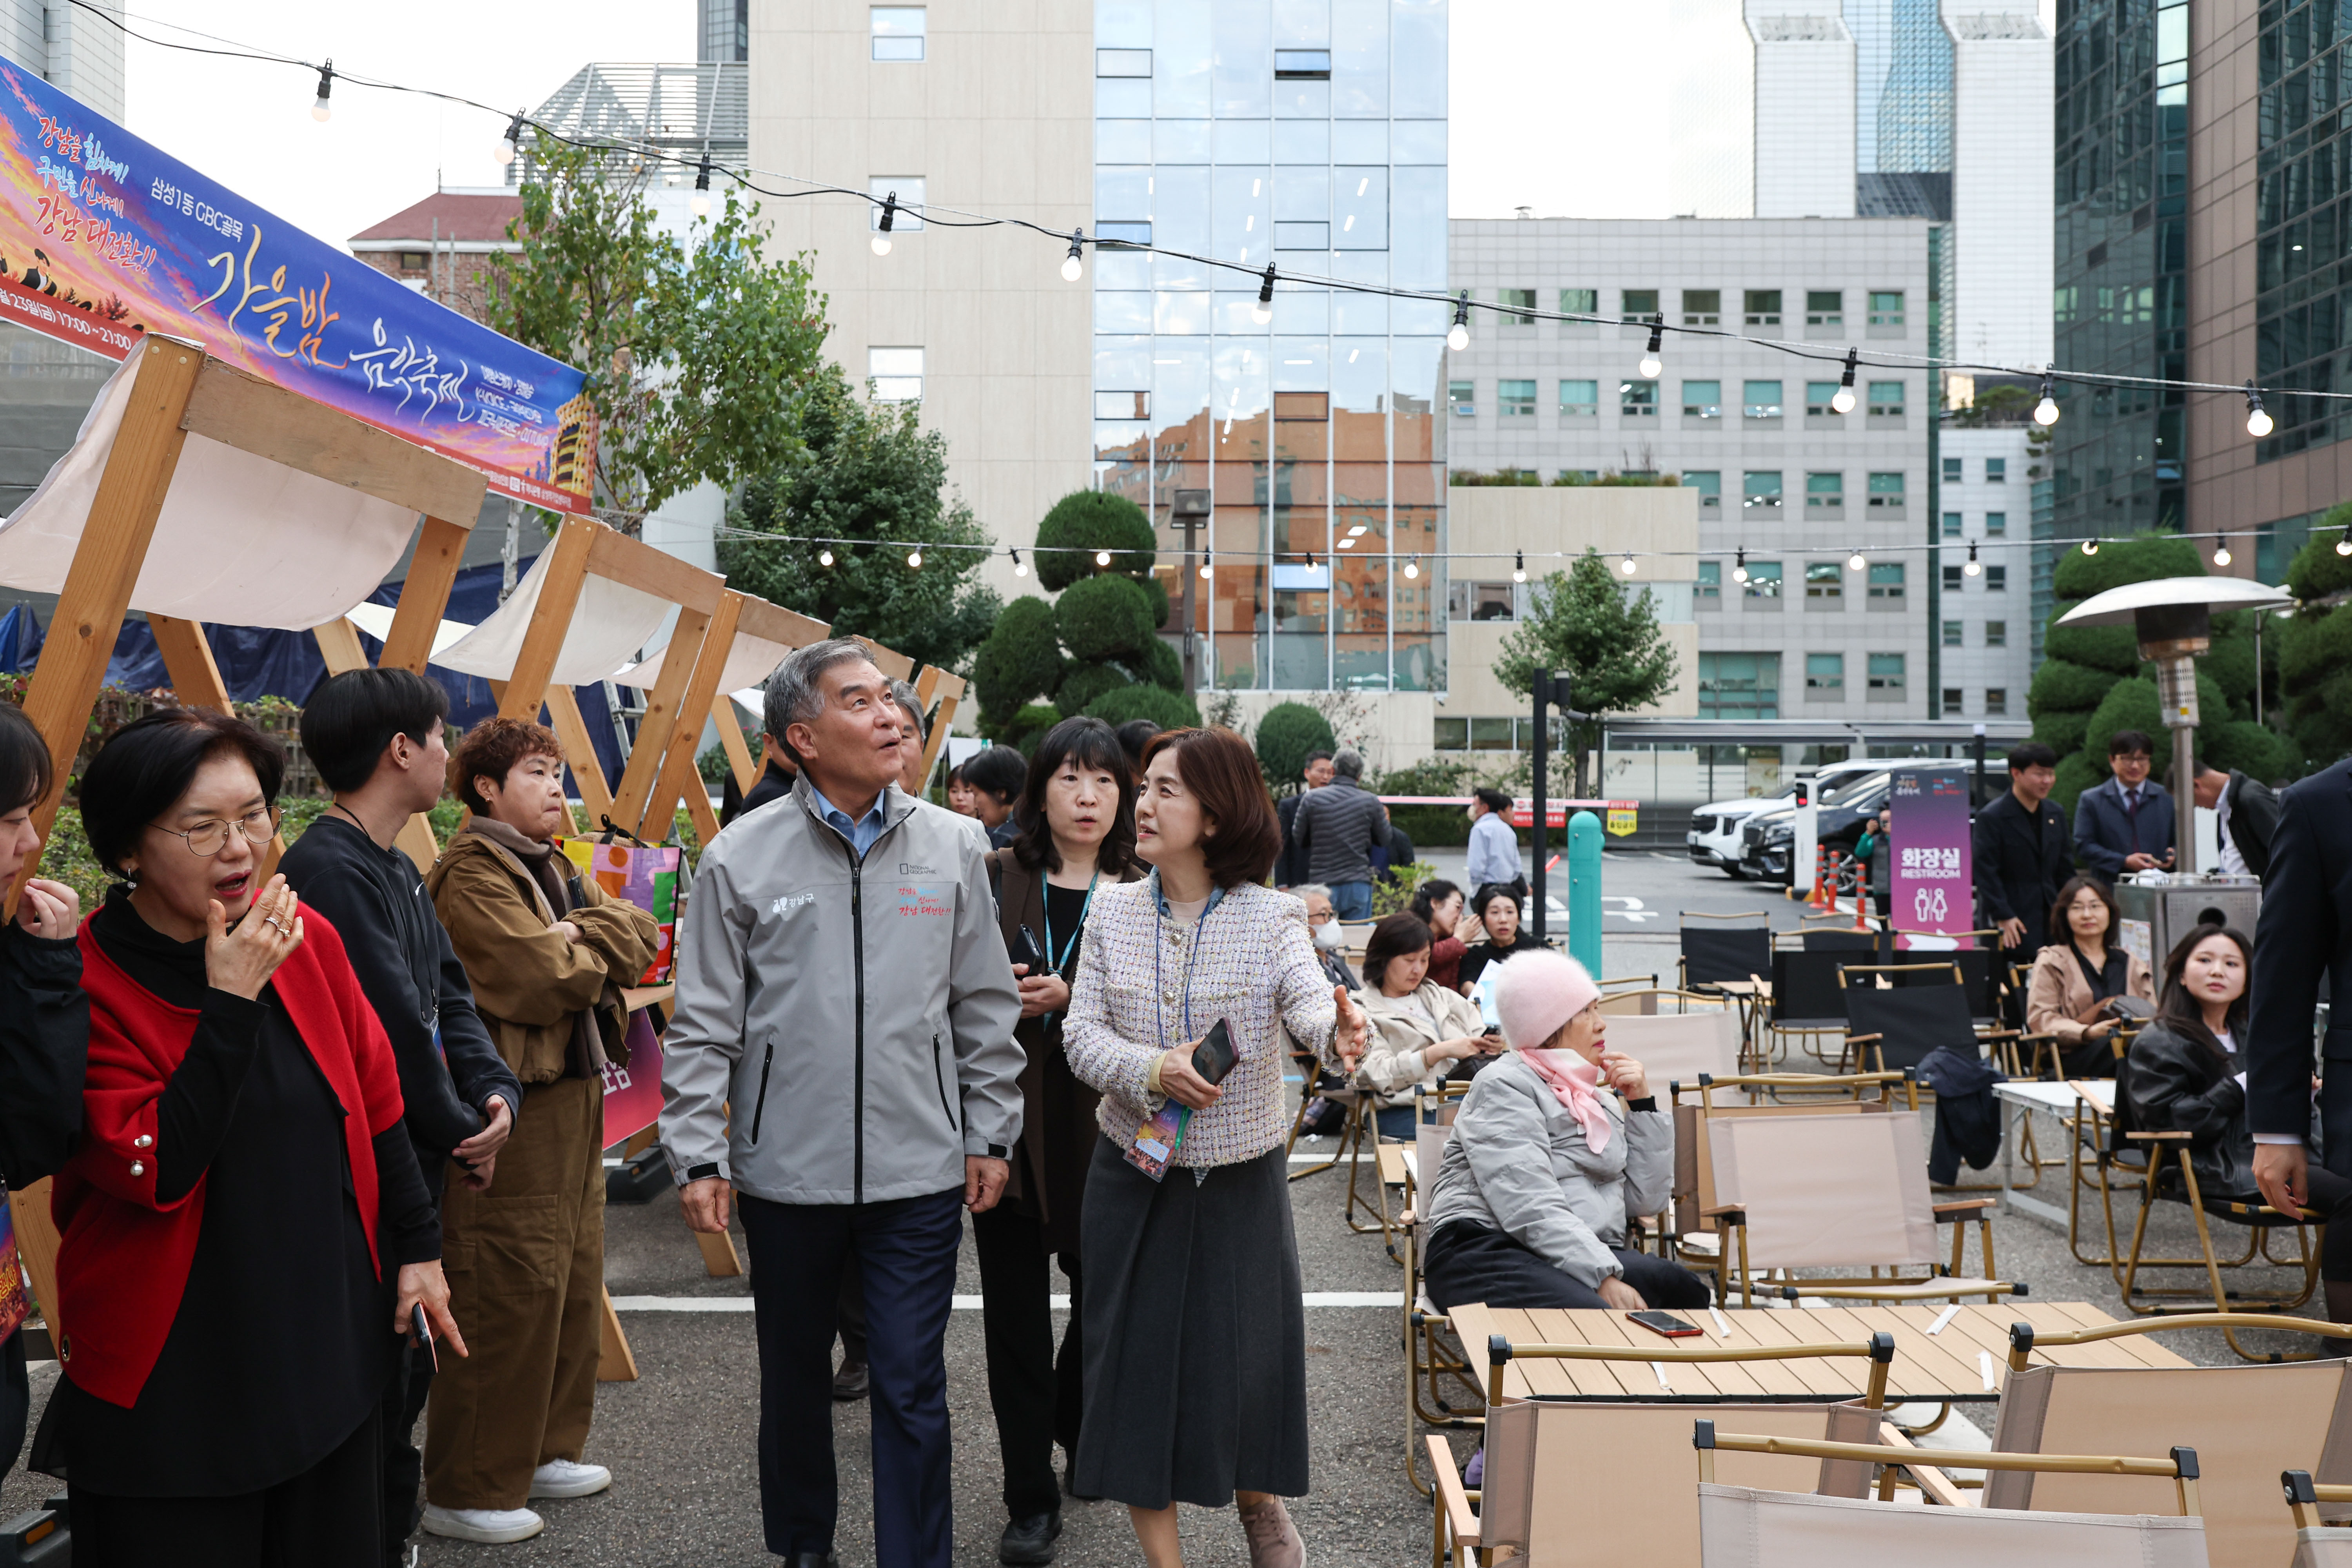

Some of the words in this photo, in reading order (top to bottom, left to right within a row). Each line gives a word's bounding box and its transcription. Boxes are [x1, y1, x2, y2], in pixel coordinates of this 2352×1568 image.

[38, 116, 82, 162] 강남을
[83, 132, 129, 184] 힘차게!
[37, 156, 78, 198] 구민을
[80, 176, 124, 218] 신나게!
[151, 177, 194, 216] 삼성1동
[34, 194, 83, 243] 강남
[87, 218, 157, 274] 대전환!!
[9, 293, 56, 323] 23일(금)
[189, 223, 349, 370] 가을밤
[349, 317, 475, 427] 음악축제
[1901, 848, 1960, 869] 화장실
[1901, 868, 1961, 879] RESTROOM
[789, 893, 815, 908] 강남구
[898, 905, 918, 916] 강남
[921, 905, 951, 916] 대전환!!
